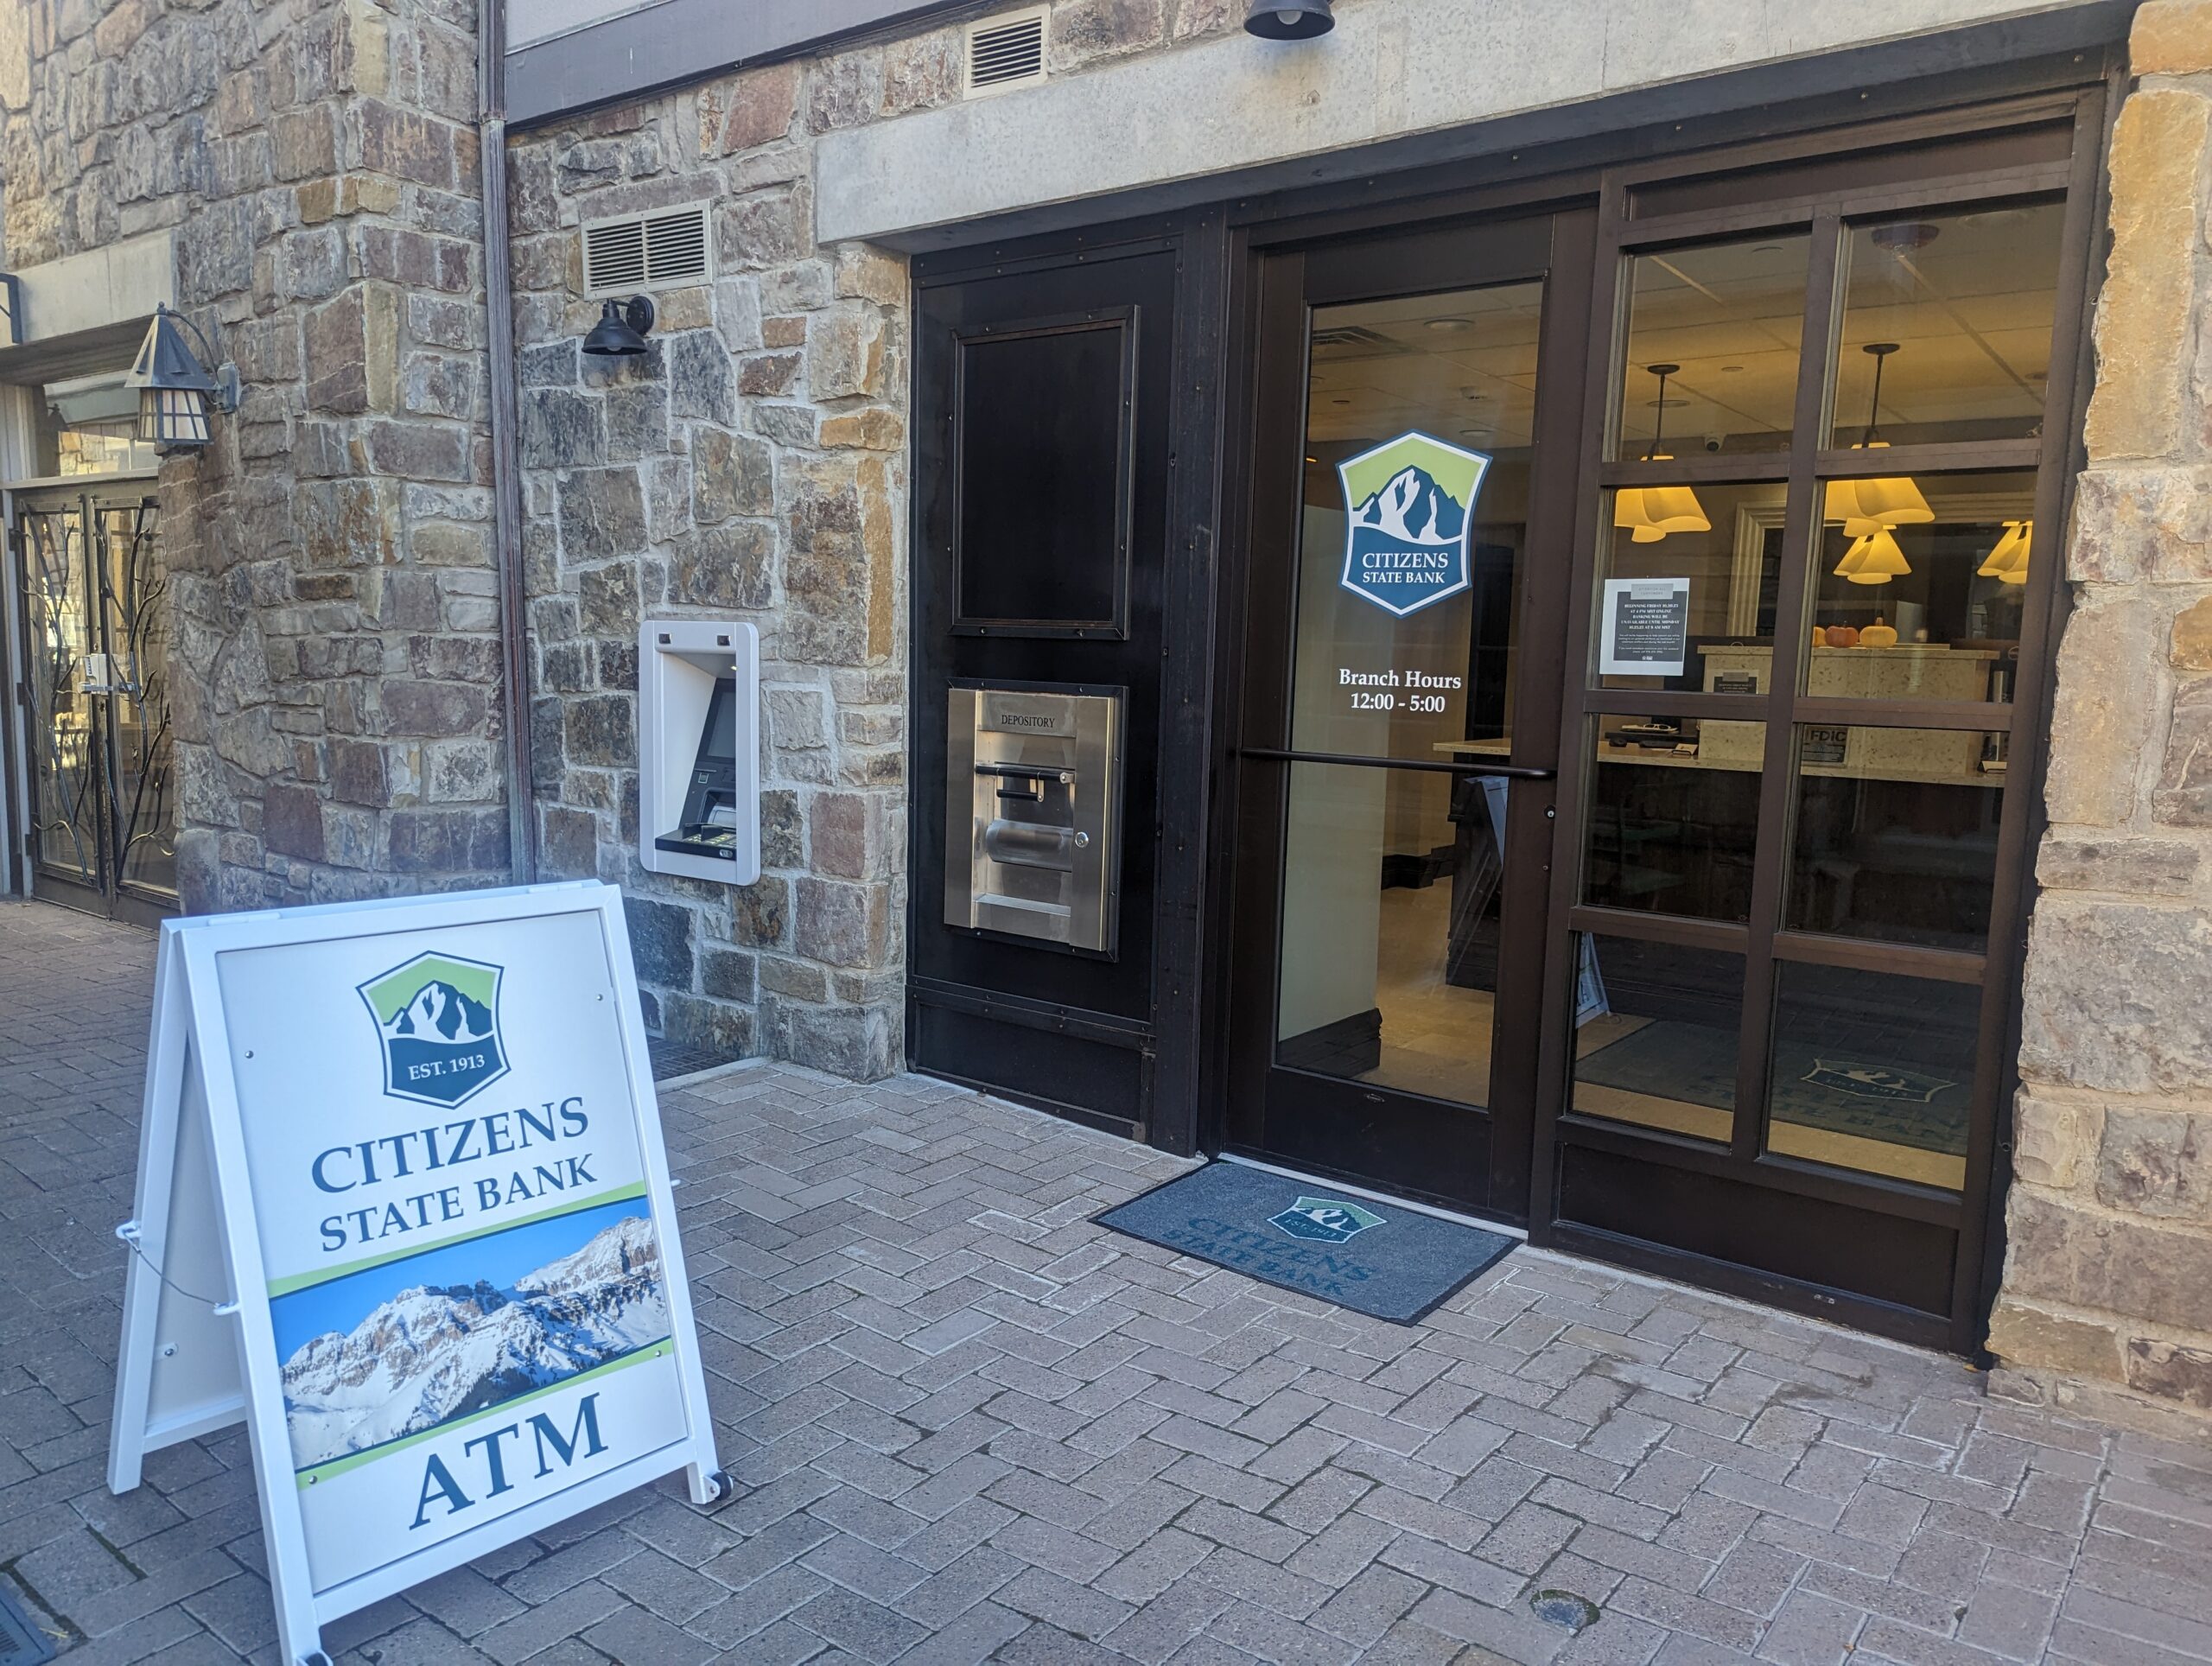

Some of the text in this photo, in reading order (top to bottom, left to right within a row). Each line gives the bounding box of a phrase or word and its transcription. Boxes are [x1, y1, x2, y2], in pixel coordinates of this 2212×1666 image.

[1362, 552, 1449, 569] CITIZENS
[1362, 571, 1446, 584] STATE BANK
[1338, 669, 1462, 689] Branch Hours
[1351, 693, 1394, 710] 12:00
[1409, 695, 1446, 713] 5:00
[1001, 715, 1056, 728] DEPOSITORY
[1810, 730, 1847, 741] FDIC
[408, 1054, 486, 1082] EST. 1913
[311, 1097, 589, 1194] CITIZENS
[319, 1153, 598, 1253] STATE BANK
[1163, 1229, 1254, 1264] STATE
[1188, 1218, 1376, 1281] CITIZENS
[408, 1391, 609, 1530] ATM
